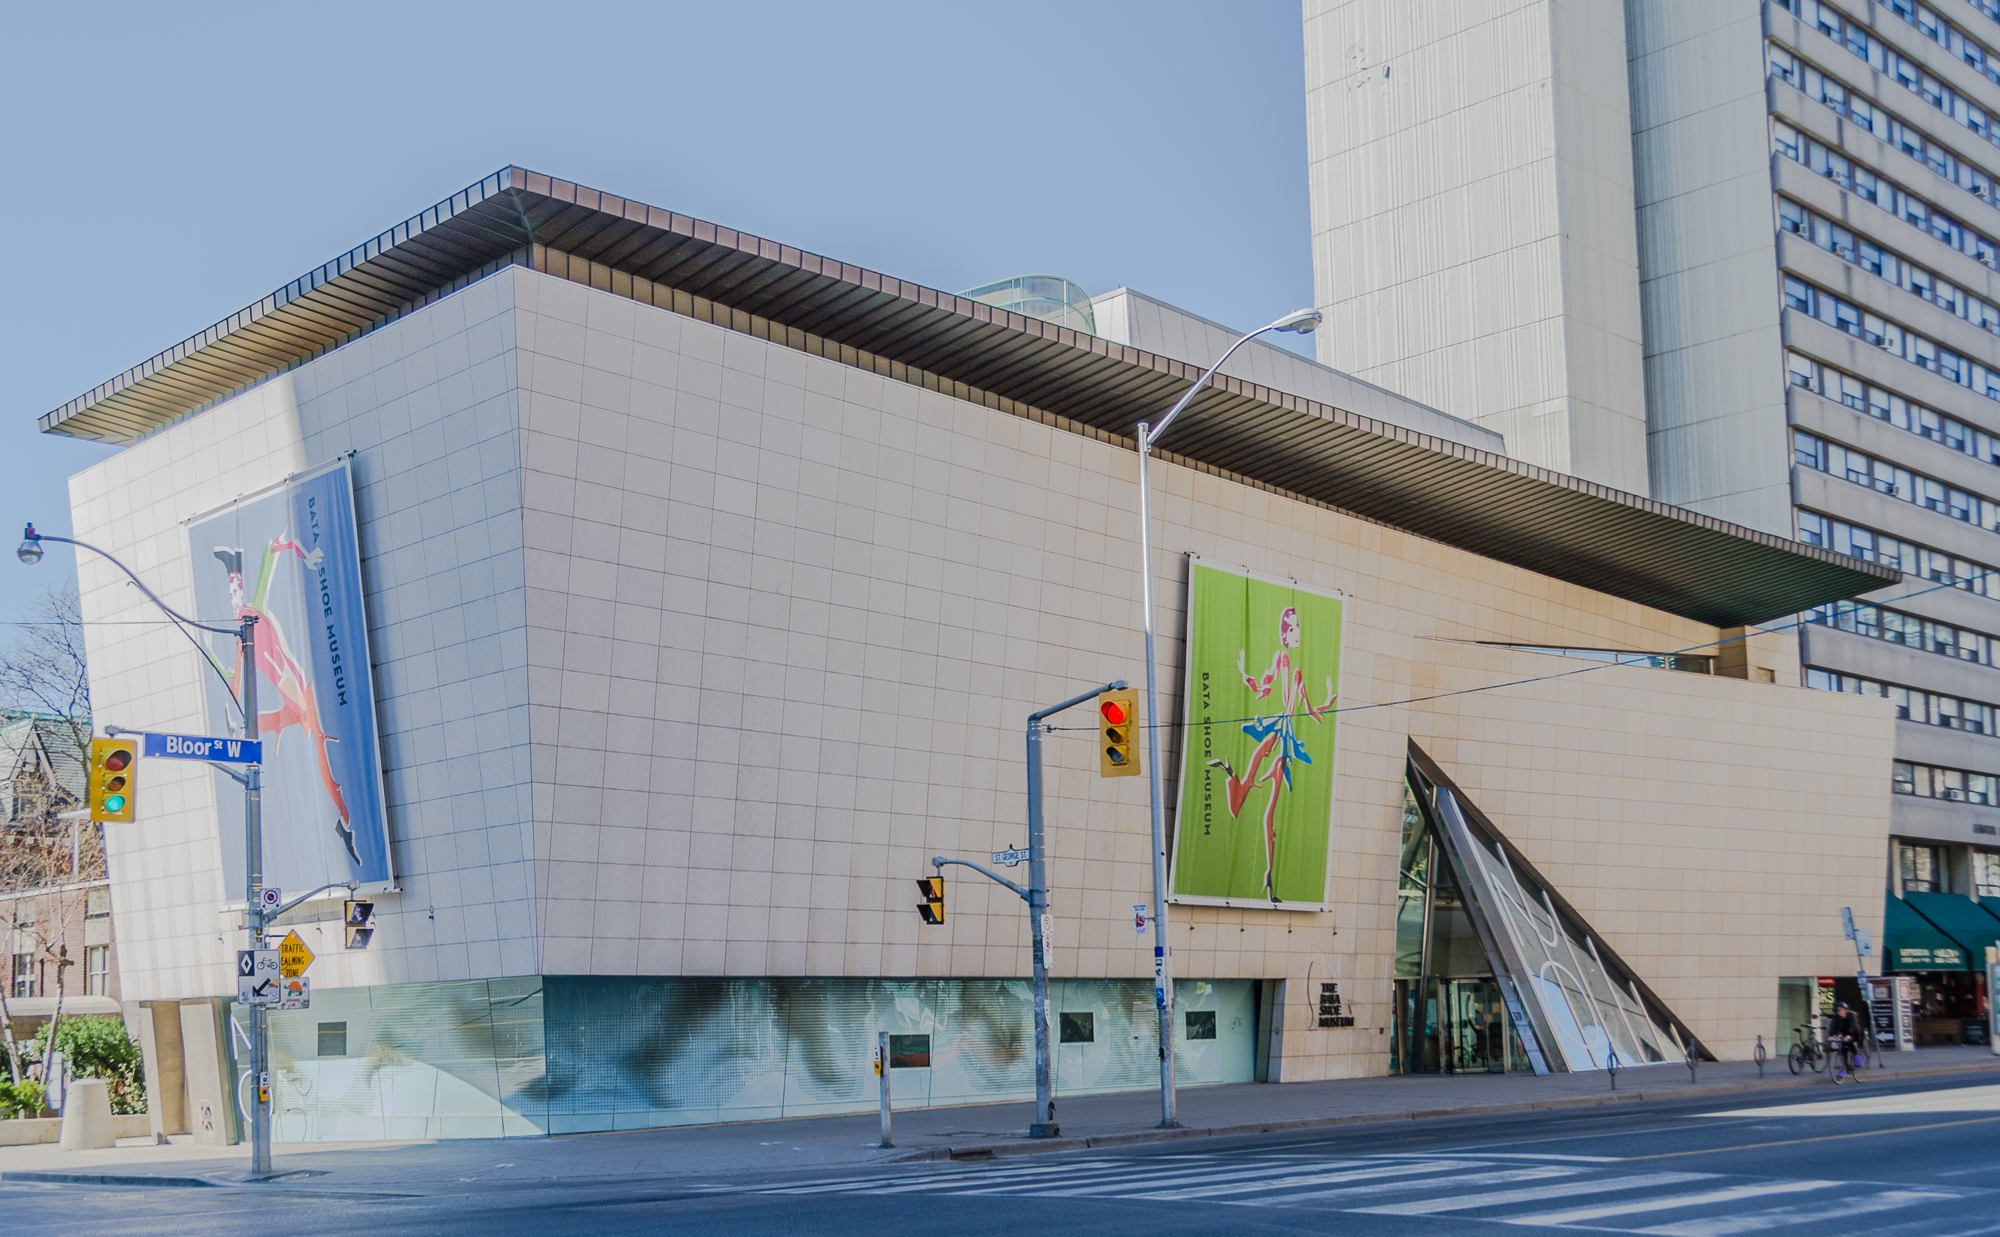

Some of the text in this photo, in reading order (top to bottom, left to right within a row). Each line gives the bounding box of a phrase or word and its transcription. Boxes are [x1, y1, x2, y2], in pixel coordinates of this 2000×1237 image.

[308, 497, 347, 707] BATA SHOE MUSEUM
[1202, 672, 1210, 710] BATA
[1203, 716, 1211, 758] SHOE
[166, 736, 241, 758] Bloor St W
[1002, 851, 1019, 861] GEORGE
[281, 944, 304, 953] TRAFFIC
[281, 956, 304, 966] CALMING
[285, 969, 299, 978] ZONE
[1321, 983, 1338, 993] THE
[1320, 994, 1341, 1005] BATA
[1319, 1005, 1342, 1016] SHOE
[1318, 1017, 1355, 1028] MUSEUM
